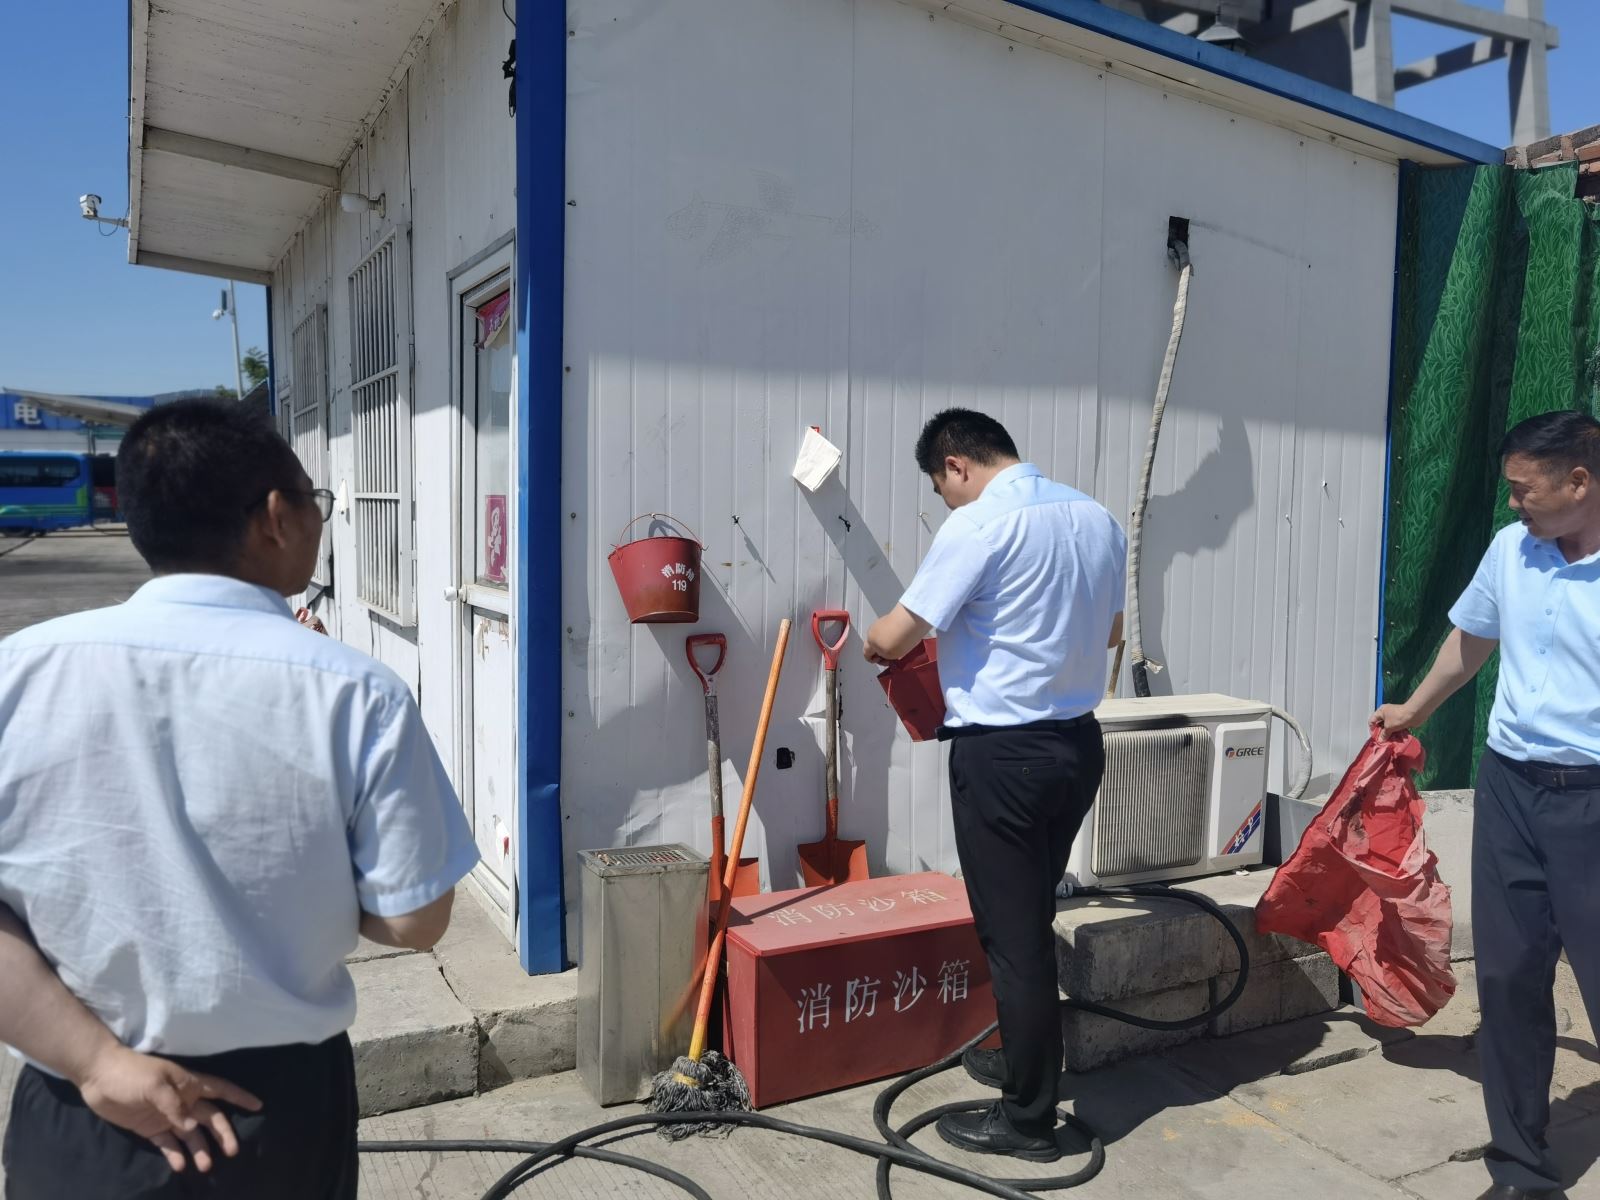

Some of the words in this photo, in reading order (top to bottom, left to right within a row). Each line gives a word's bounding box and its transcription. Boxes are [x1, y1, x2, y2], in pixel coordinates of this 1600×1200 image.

[672, 580, 687, 592] 119
[1236, 746, 1265, 757] GREE
[767, 888, 948, 926] 消防沙箱
[797, 959, 971, 1033] 消防沙箱
